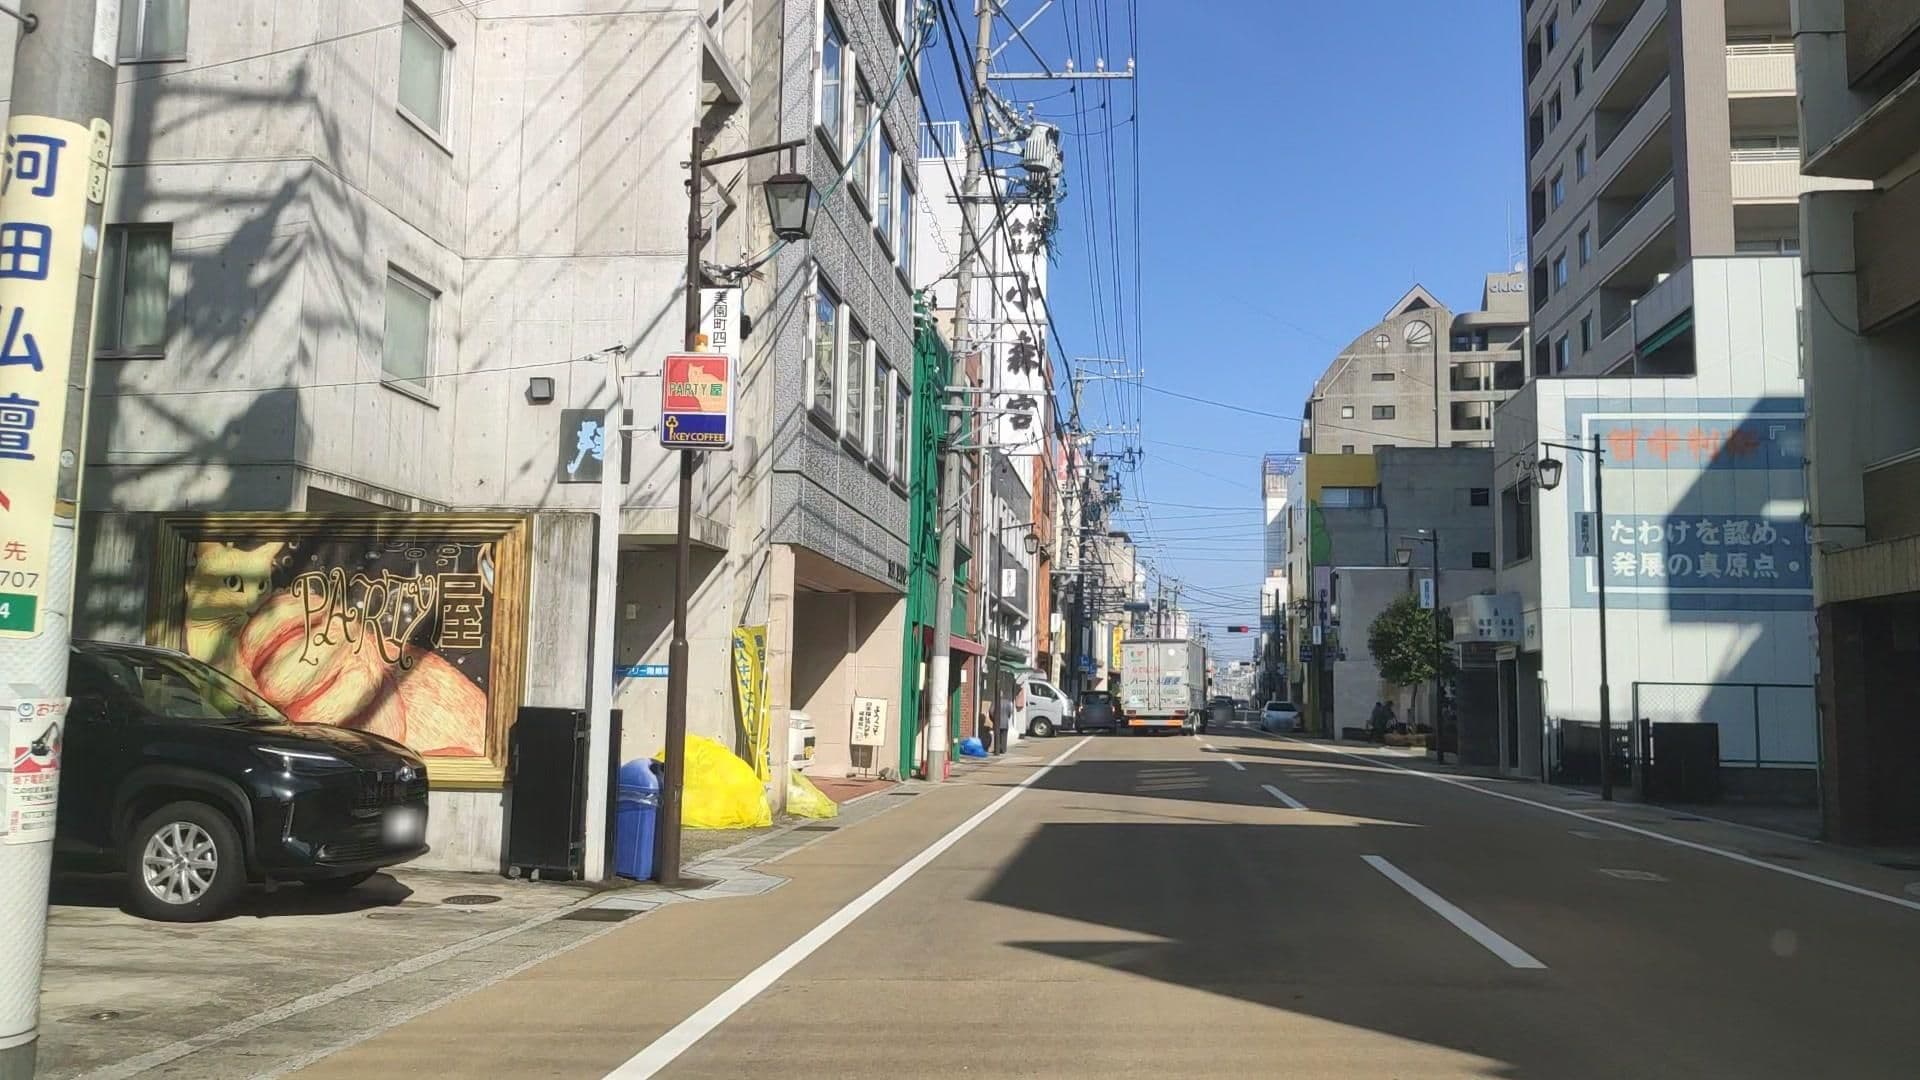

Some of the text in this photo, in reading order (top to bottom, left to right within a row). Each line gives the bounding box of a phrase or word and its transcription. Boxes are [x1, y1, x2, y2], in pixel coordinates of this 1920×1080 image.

[669, 383, 723, 396] PARTY屋
[4, 540, 27, 562] 先
[291, 567, 486, 672] PARTY屋
